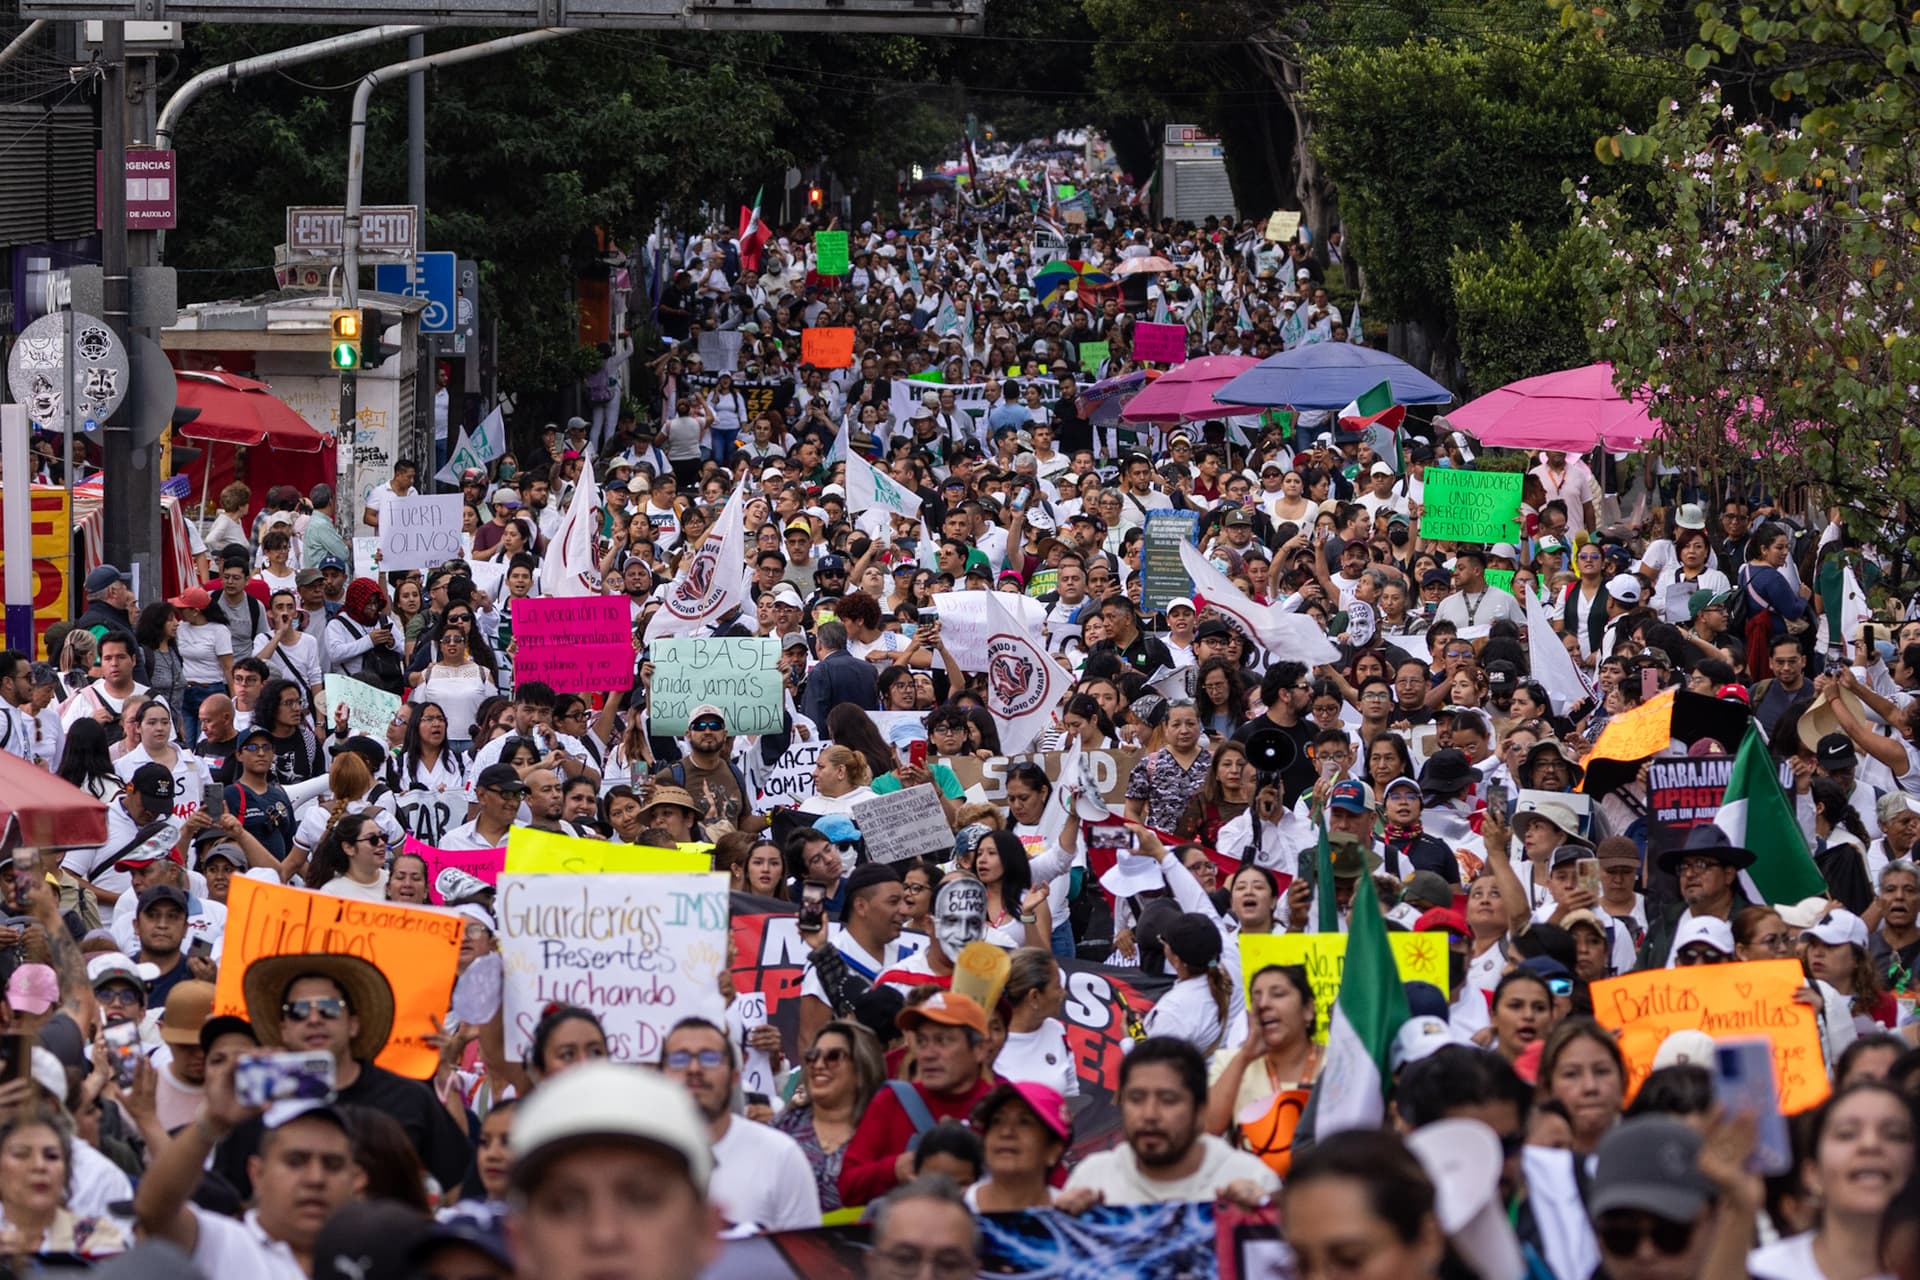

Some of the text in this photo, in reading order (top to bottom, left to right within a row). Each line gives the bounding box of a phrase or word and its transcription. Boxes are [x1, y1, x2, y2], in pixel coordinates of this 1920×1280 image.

[129, 210, 171, 218] DE AUXILIO
[389, 529, 460, 555] OLIVOS
[517, 601, 538, 624] La
[652, 638, 780, 672] La BASE
[651, 665, 764, 702] unida jamás
[651, 695, 784, 733] será NCIDA
[1649, 760, 1737, 790] TRABAJAM
[1657, 808, 1678, 822] POR
[1679, 808, 1693, 820] UN
[664, 890, 730, 931] IMSS
[948, 888, 985, 902] FUERA
[948, 901, 985, 913] OLIVOS
[539, 938, 677, 974] Presentes
[536, 971, 676, 1008] Luchando
[1612, 983, 1802, 1032] Batitas Amarillas
